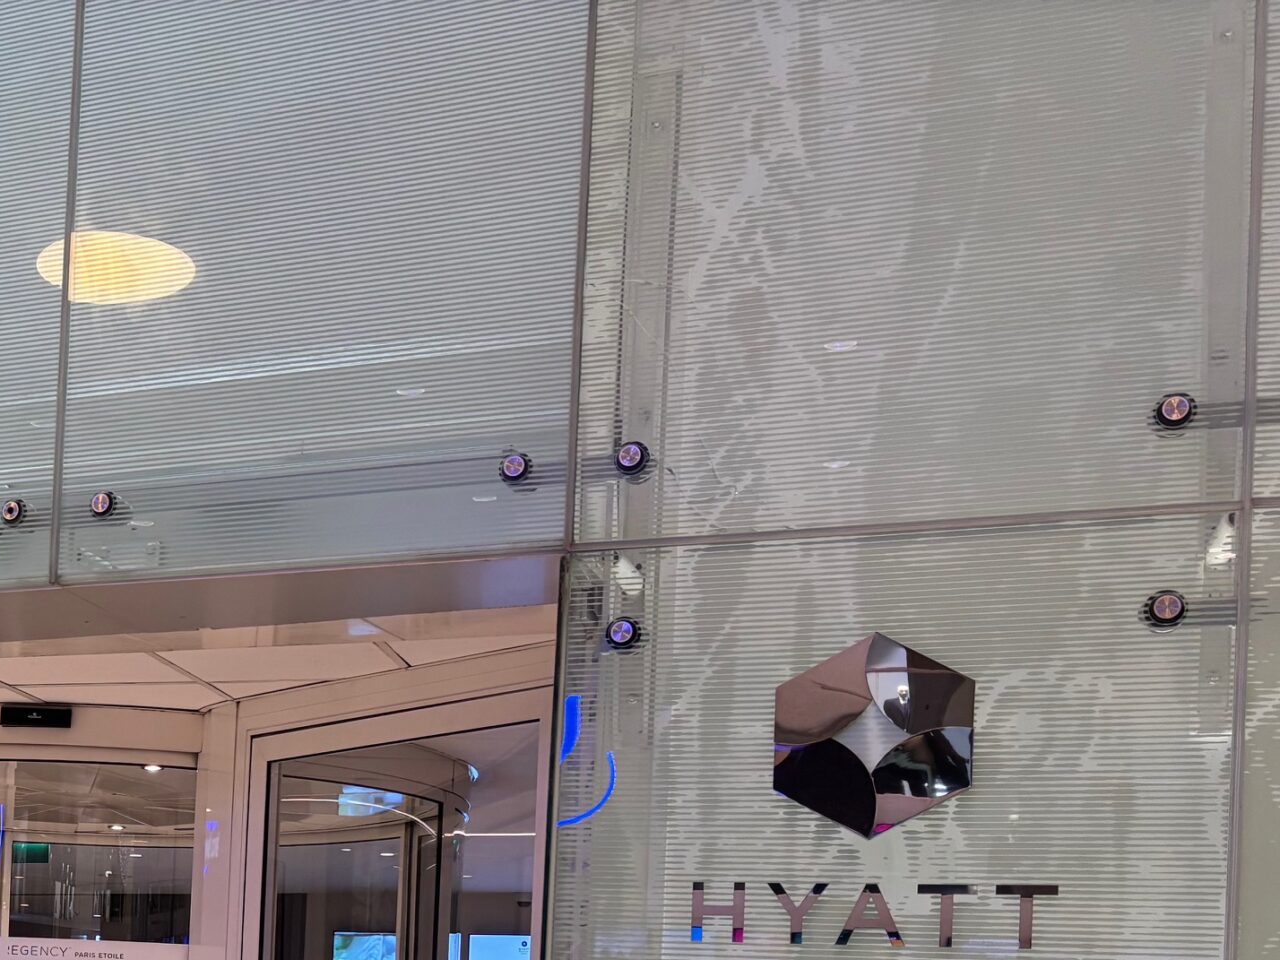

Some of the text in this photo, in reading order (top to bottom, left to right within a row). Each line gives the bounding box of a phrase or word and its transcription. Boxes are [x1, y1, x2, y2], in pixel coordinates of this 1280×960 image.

[691, 881, 1059, 949] HYATT
[6, 944, 69, 957] EGENCY
[74, 951, 96, 959] PARIS
[98, 952, 125, 960] ETOILE
